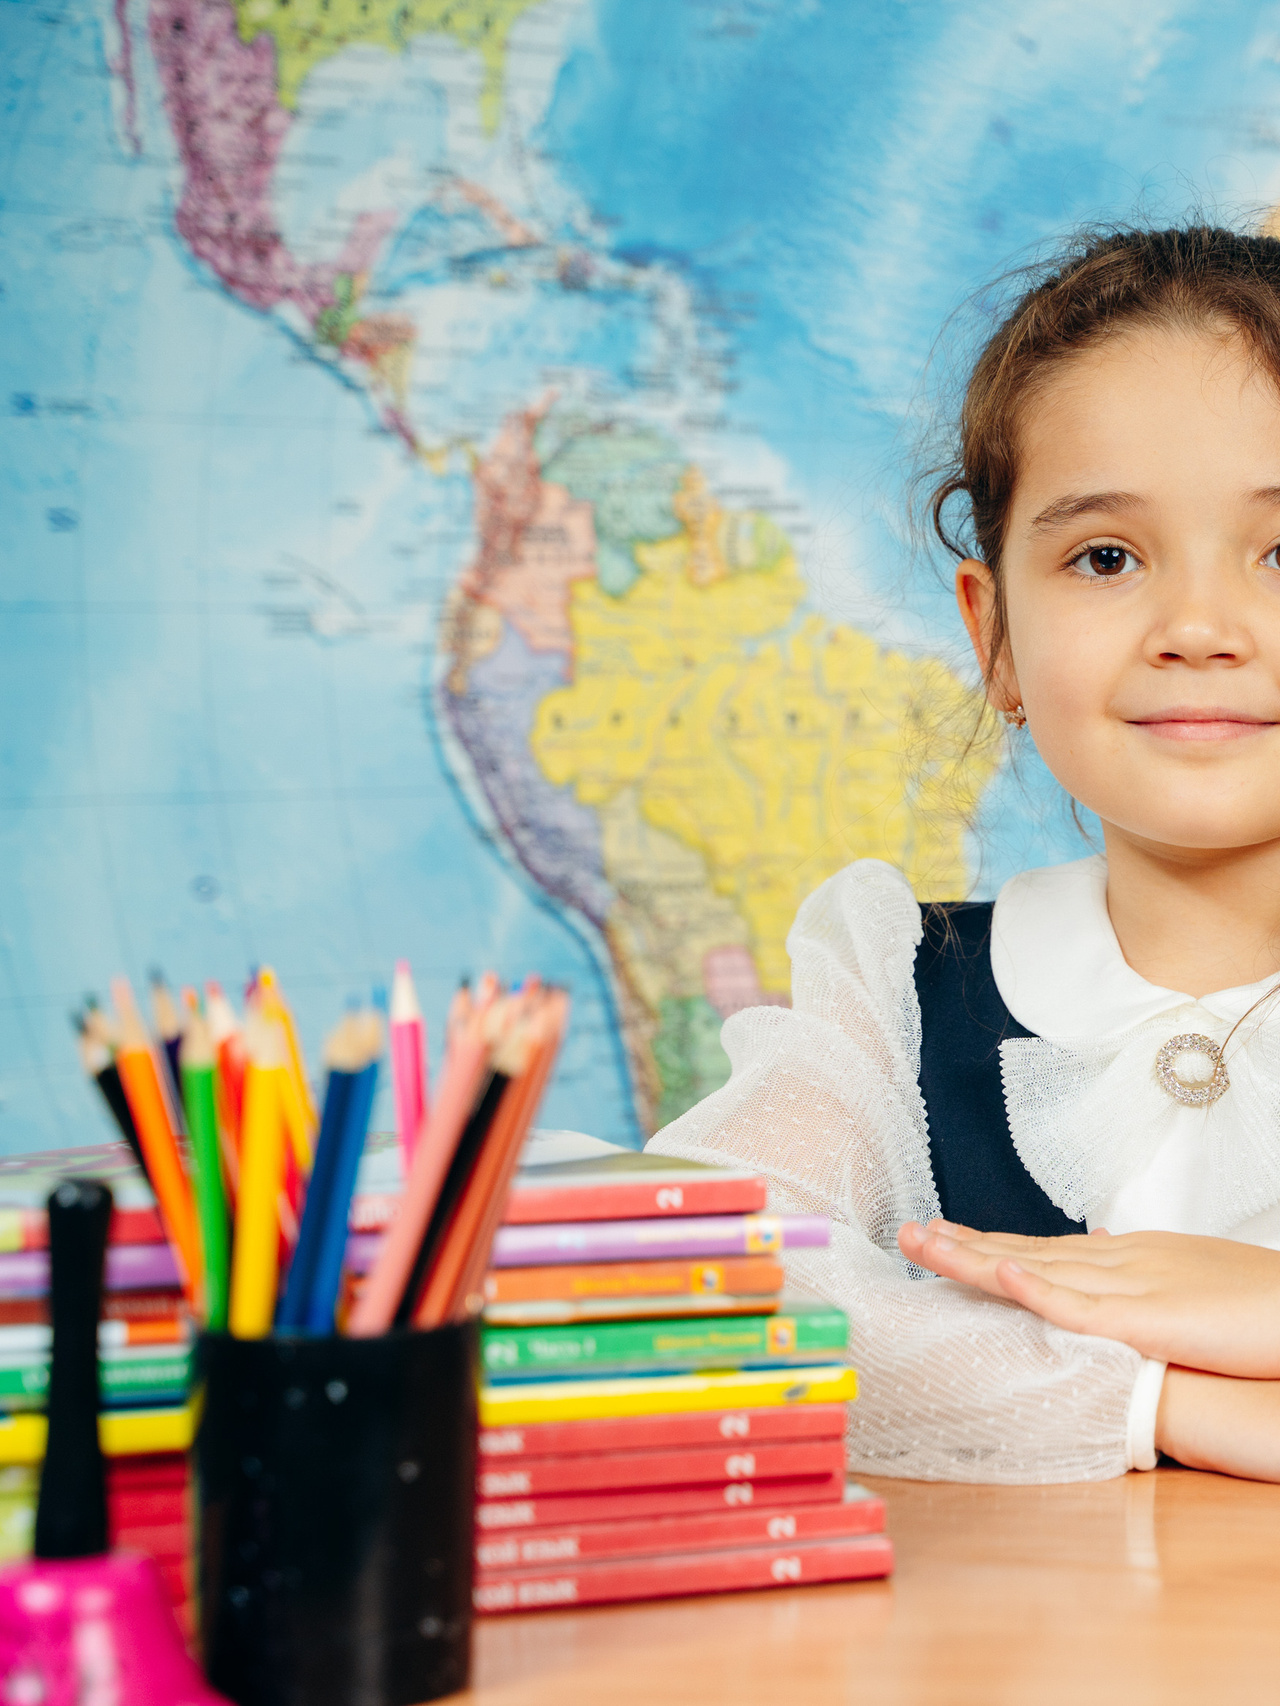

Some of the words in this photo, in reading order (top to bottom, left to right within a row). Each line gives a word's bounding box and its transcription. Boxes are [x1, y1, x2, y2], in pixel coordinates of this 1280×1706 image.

[656, 1187, 683, 1209] 2
[720, 1414, 749, 1438] 2
[726, 1453, 755, 1478] 2
[724, 1482, 753, 1506] 2
[767, 1516, 796, 1539] 2
[771, 1557, 801, 1582] 2
